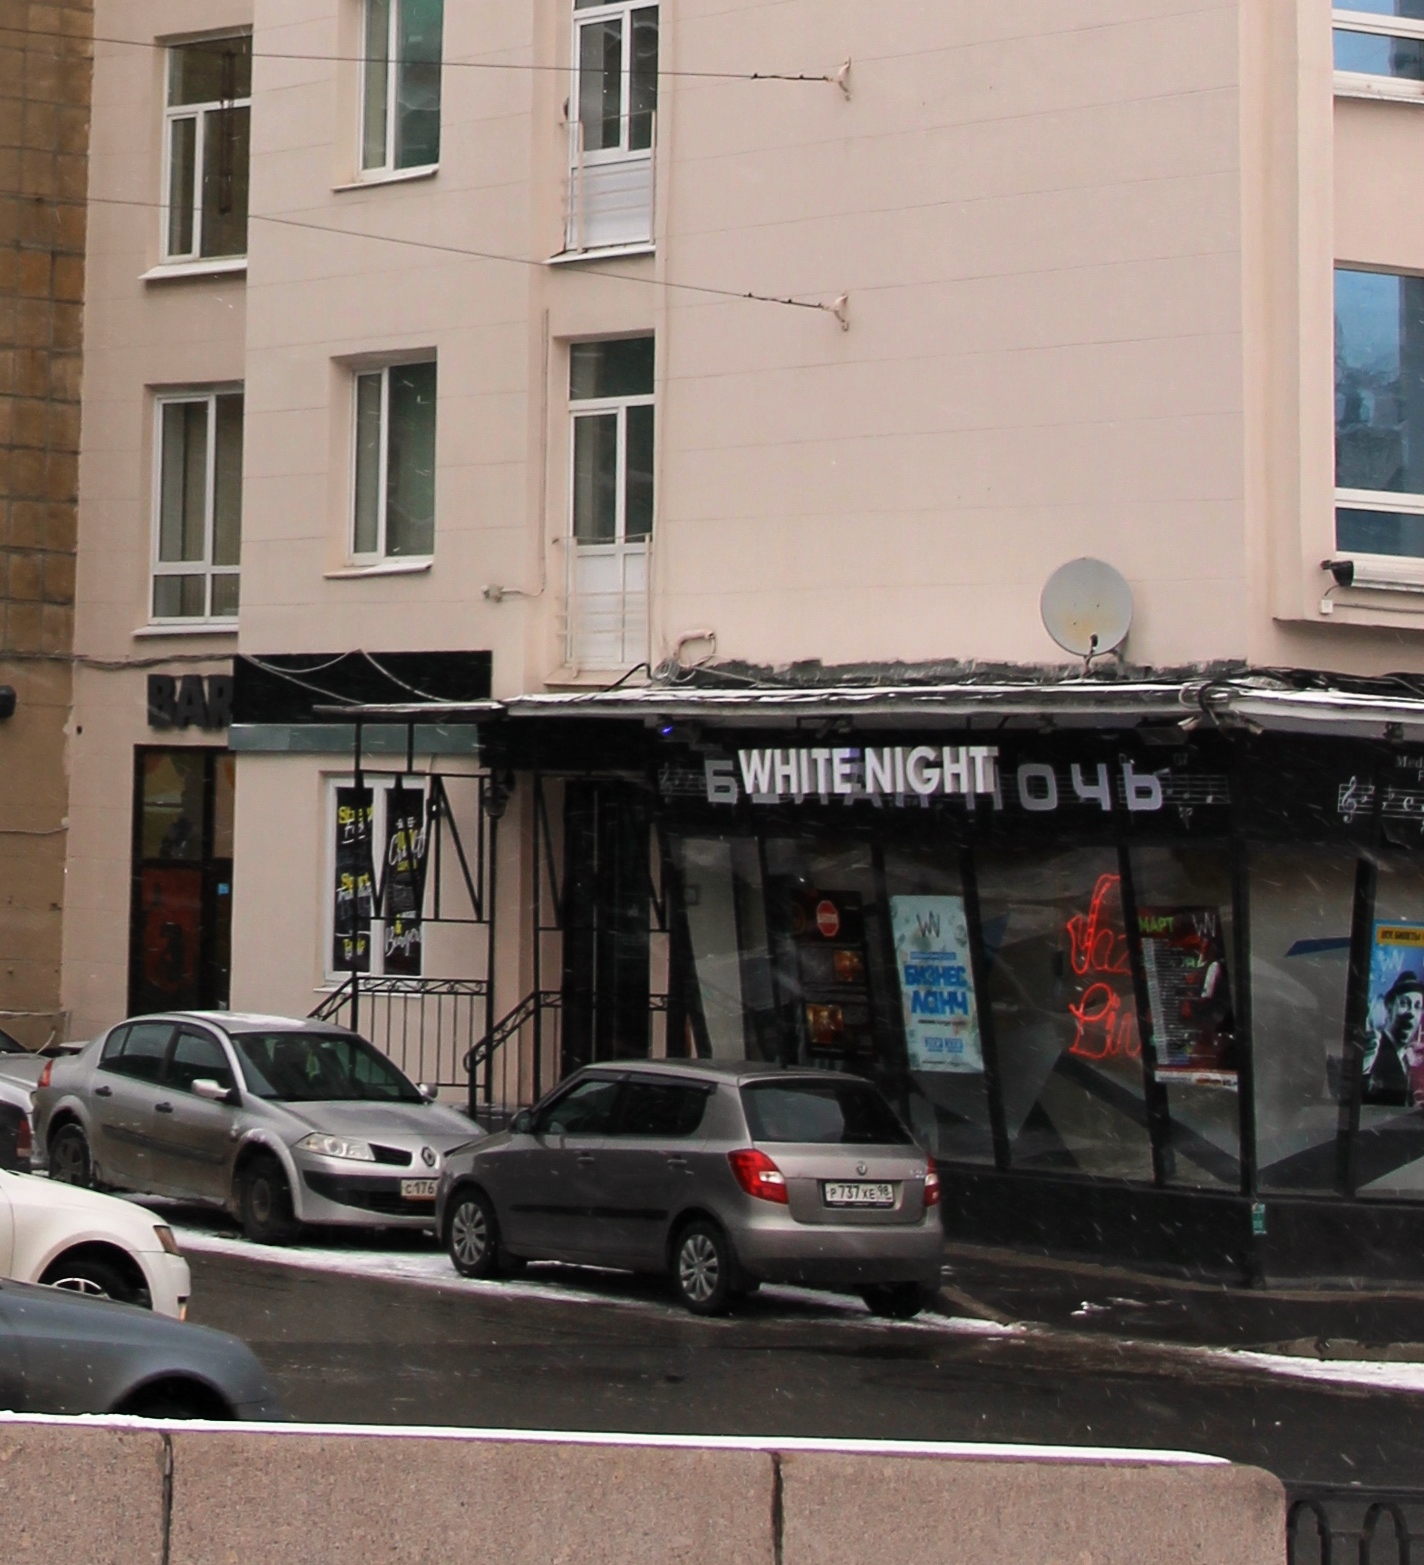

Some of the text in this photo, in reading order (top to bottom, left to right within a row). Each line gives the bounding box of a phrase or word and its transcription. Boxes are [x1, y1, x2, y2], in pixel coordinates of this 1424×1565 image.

[738, 747, 860, 795] WHITE
[864, 746, 999, 796] NIGHT
[1138, 915, 1175, 933] МАРТ
[904, 964, 968, 987] БИЗНЕС
